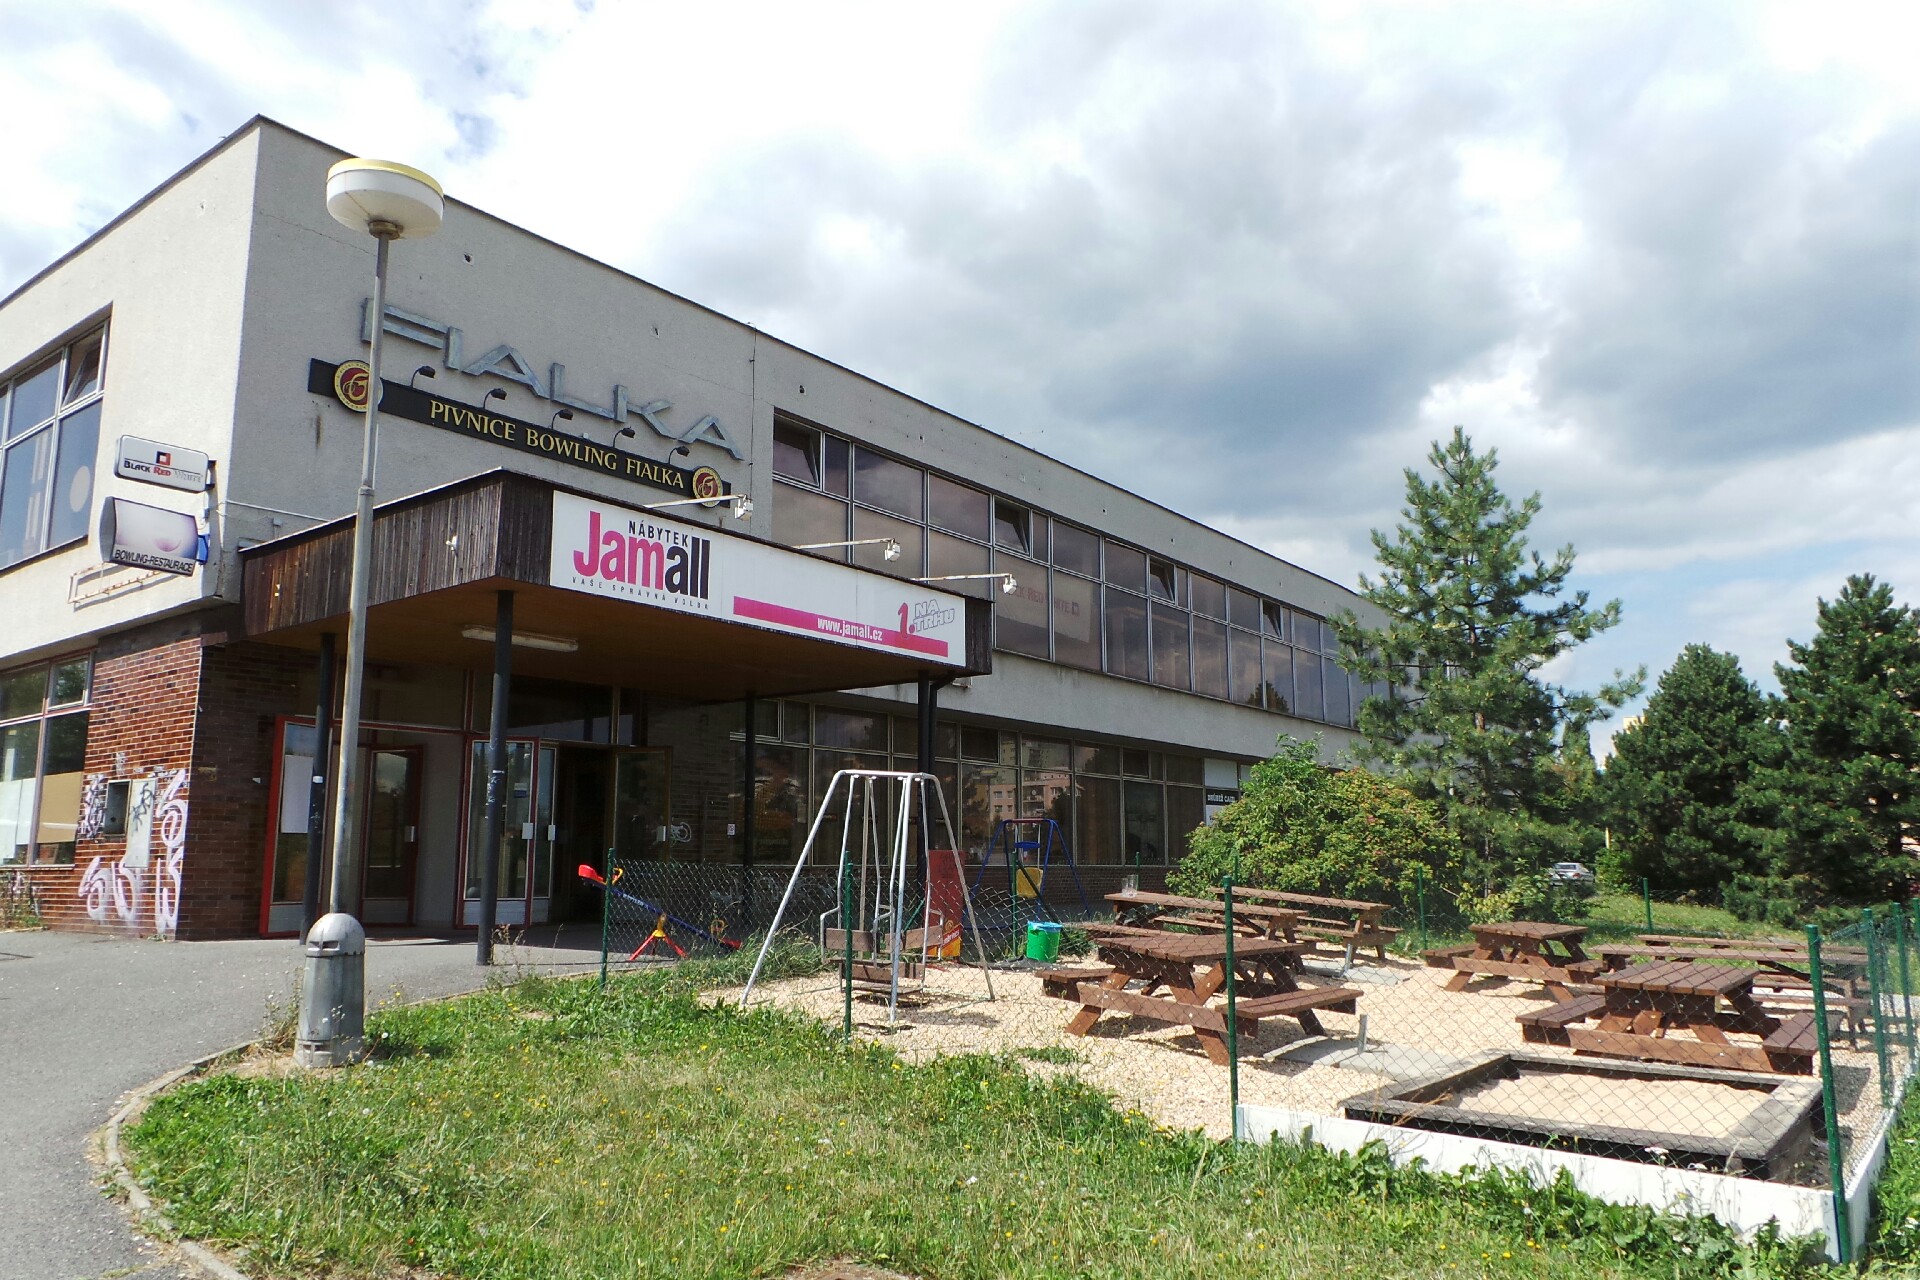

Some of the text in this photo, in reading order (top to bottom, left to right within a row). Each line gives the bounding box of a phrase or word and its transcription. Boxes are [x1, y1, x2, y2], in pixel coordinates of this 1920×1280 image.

[360, 297, 745, 461] FIALKA
[430, 400, 516, 442] PIVNICE
[526, 427, 617, 470] BOWLING
[626, 457, 684, 489] FIALKA
[123, 459, 151, 474] BLACK
[153, 465, 171, 477] RED
[628, 519, 689, 548] NÁBYTEK
[573, 510, 711, 601] Jamall
[572, 576, 603, 589] VAŠE
[913, 608, 955, 632] TRHU
[914, 599, 941, 618] NA
[817, 617, 883, 642] www.jamall.cz
